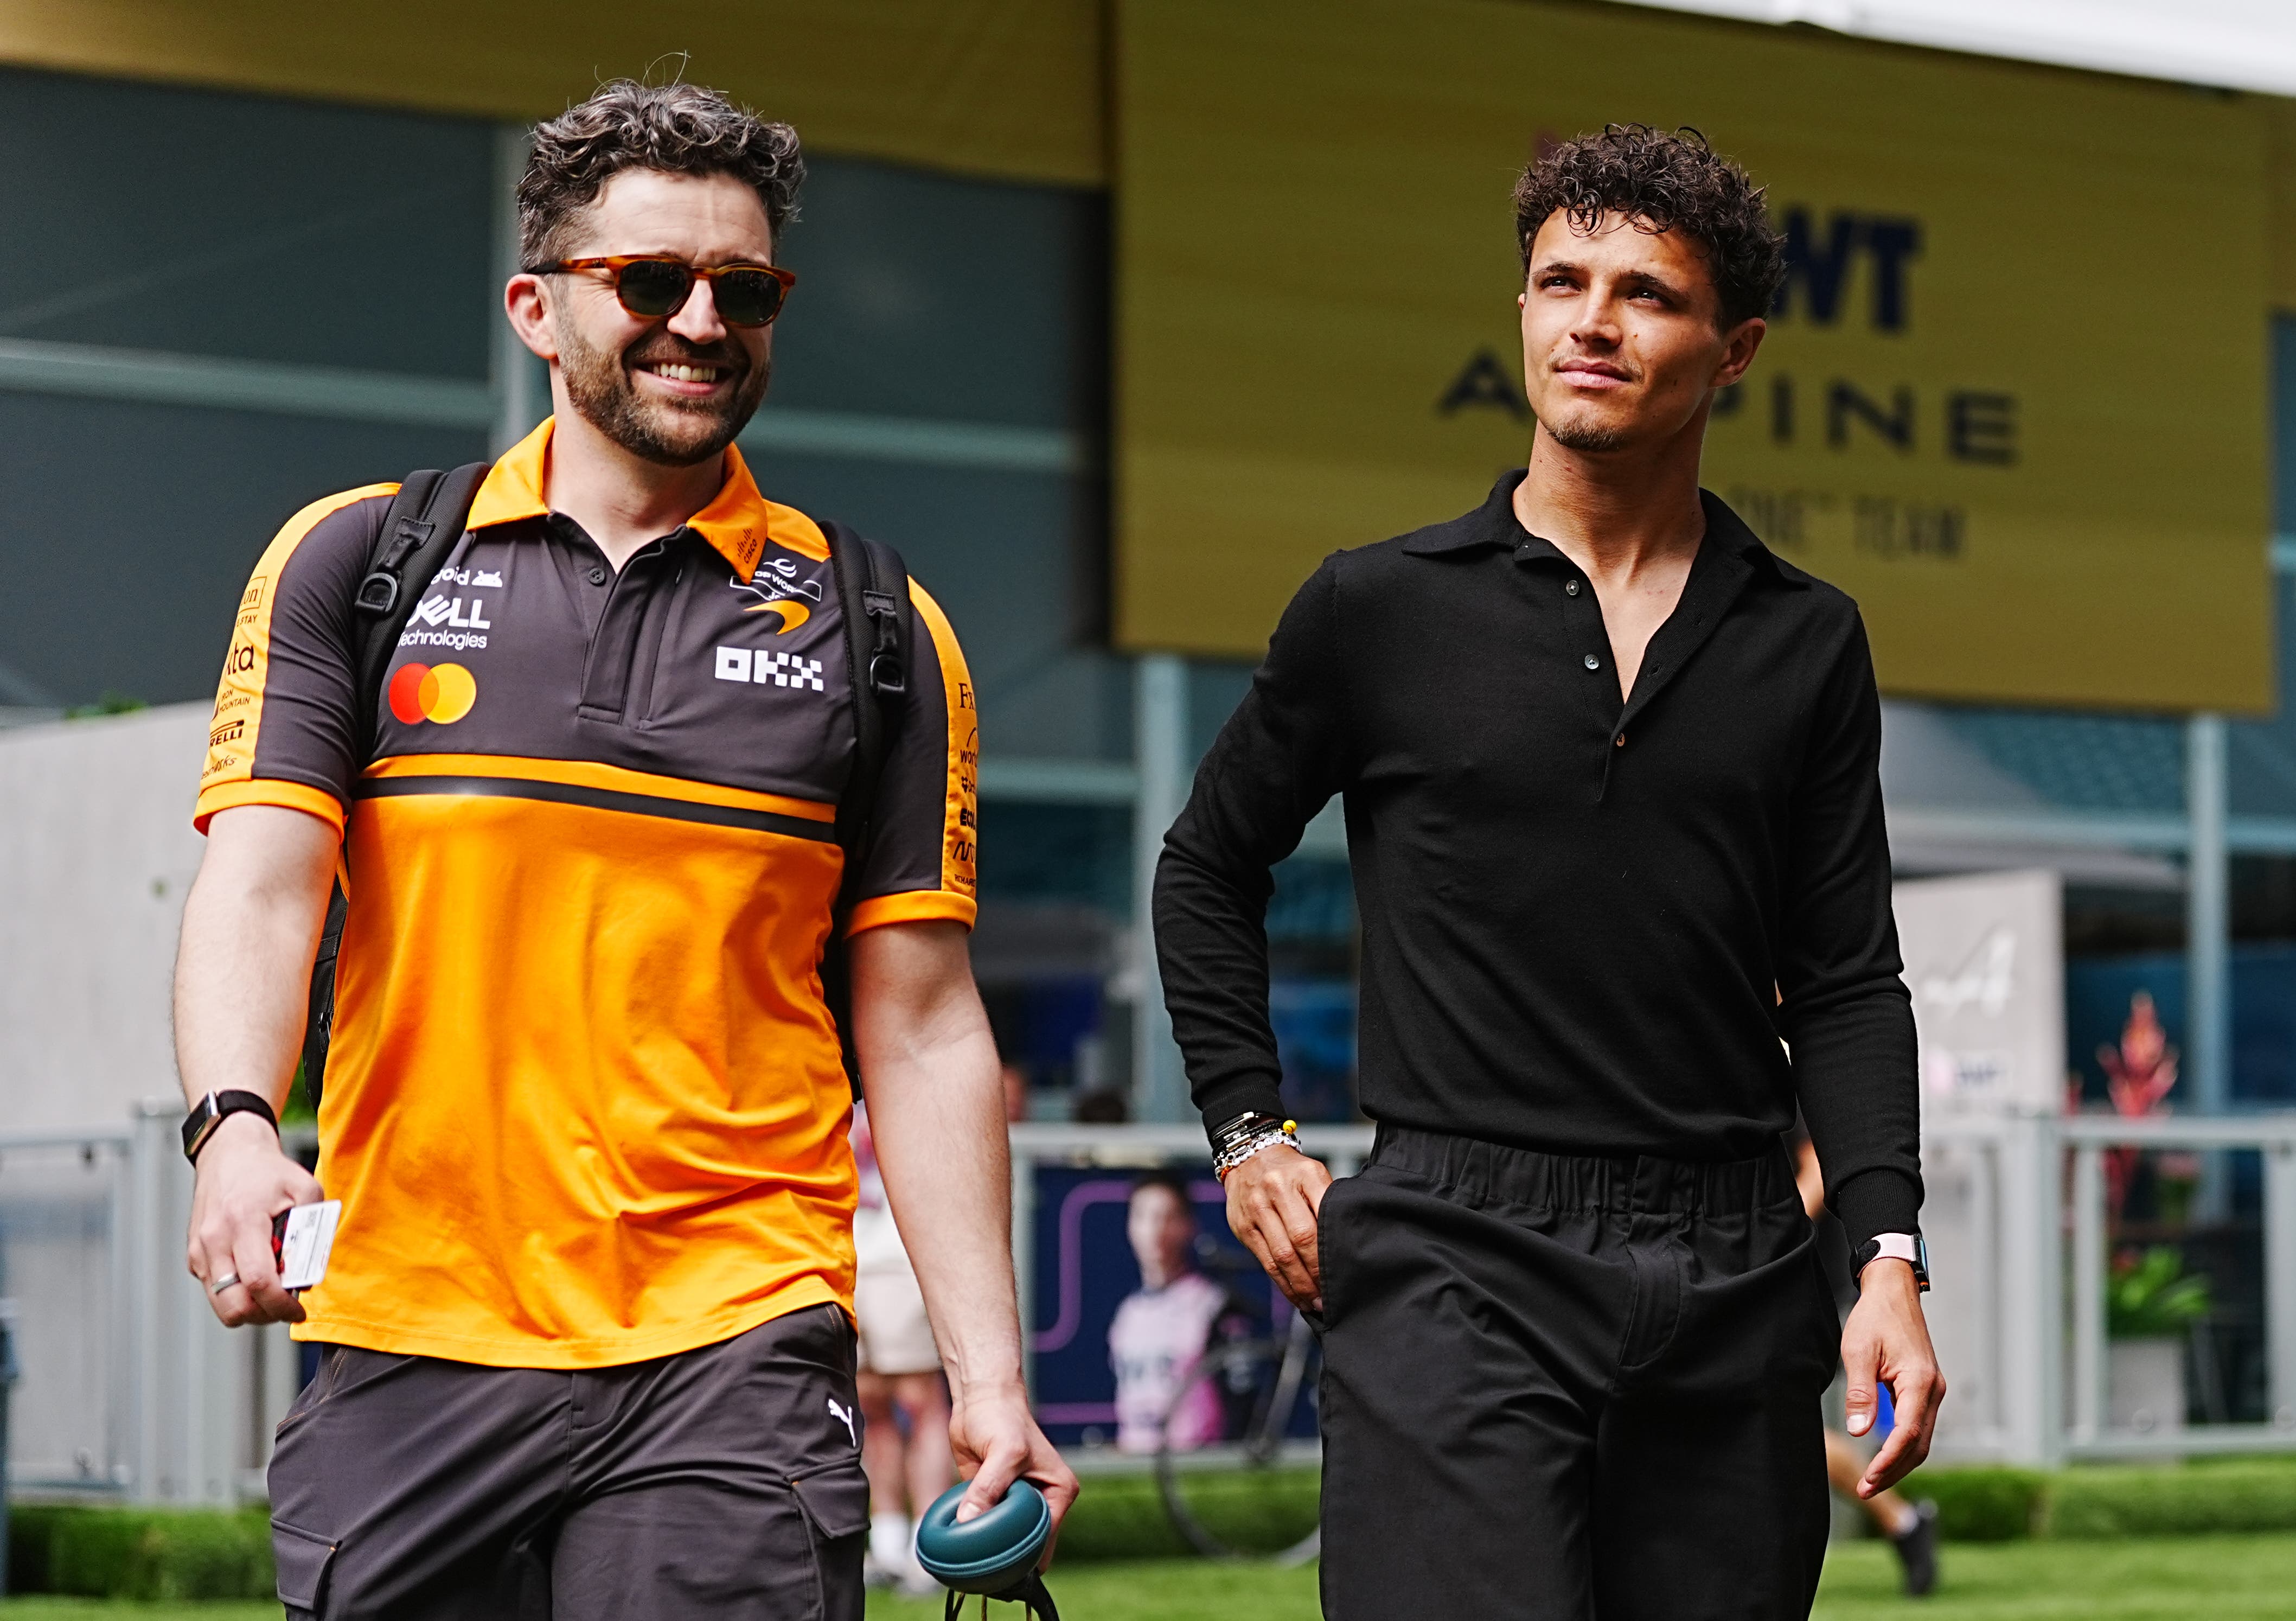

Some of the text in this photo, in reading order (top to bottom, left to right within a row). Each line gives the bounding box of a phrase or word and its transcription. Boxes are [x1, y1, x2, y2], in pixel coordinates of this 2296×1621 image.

[1767, 204, 1921, 332] WT
[743, 539, 757, 564] CISCO
[715, 646, 824, 692] OKX
